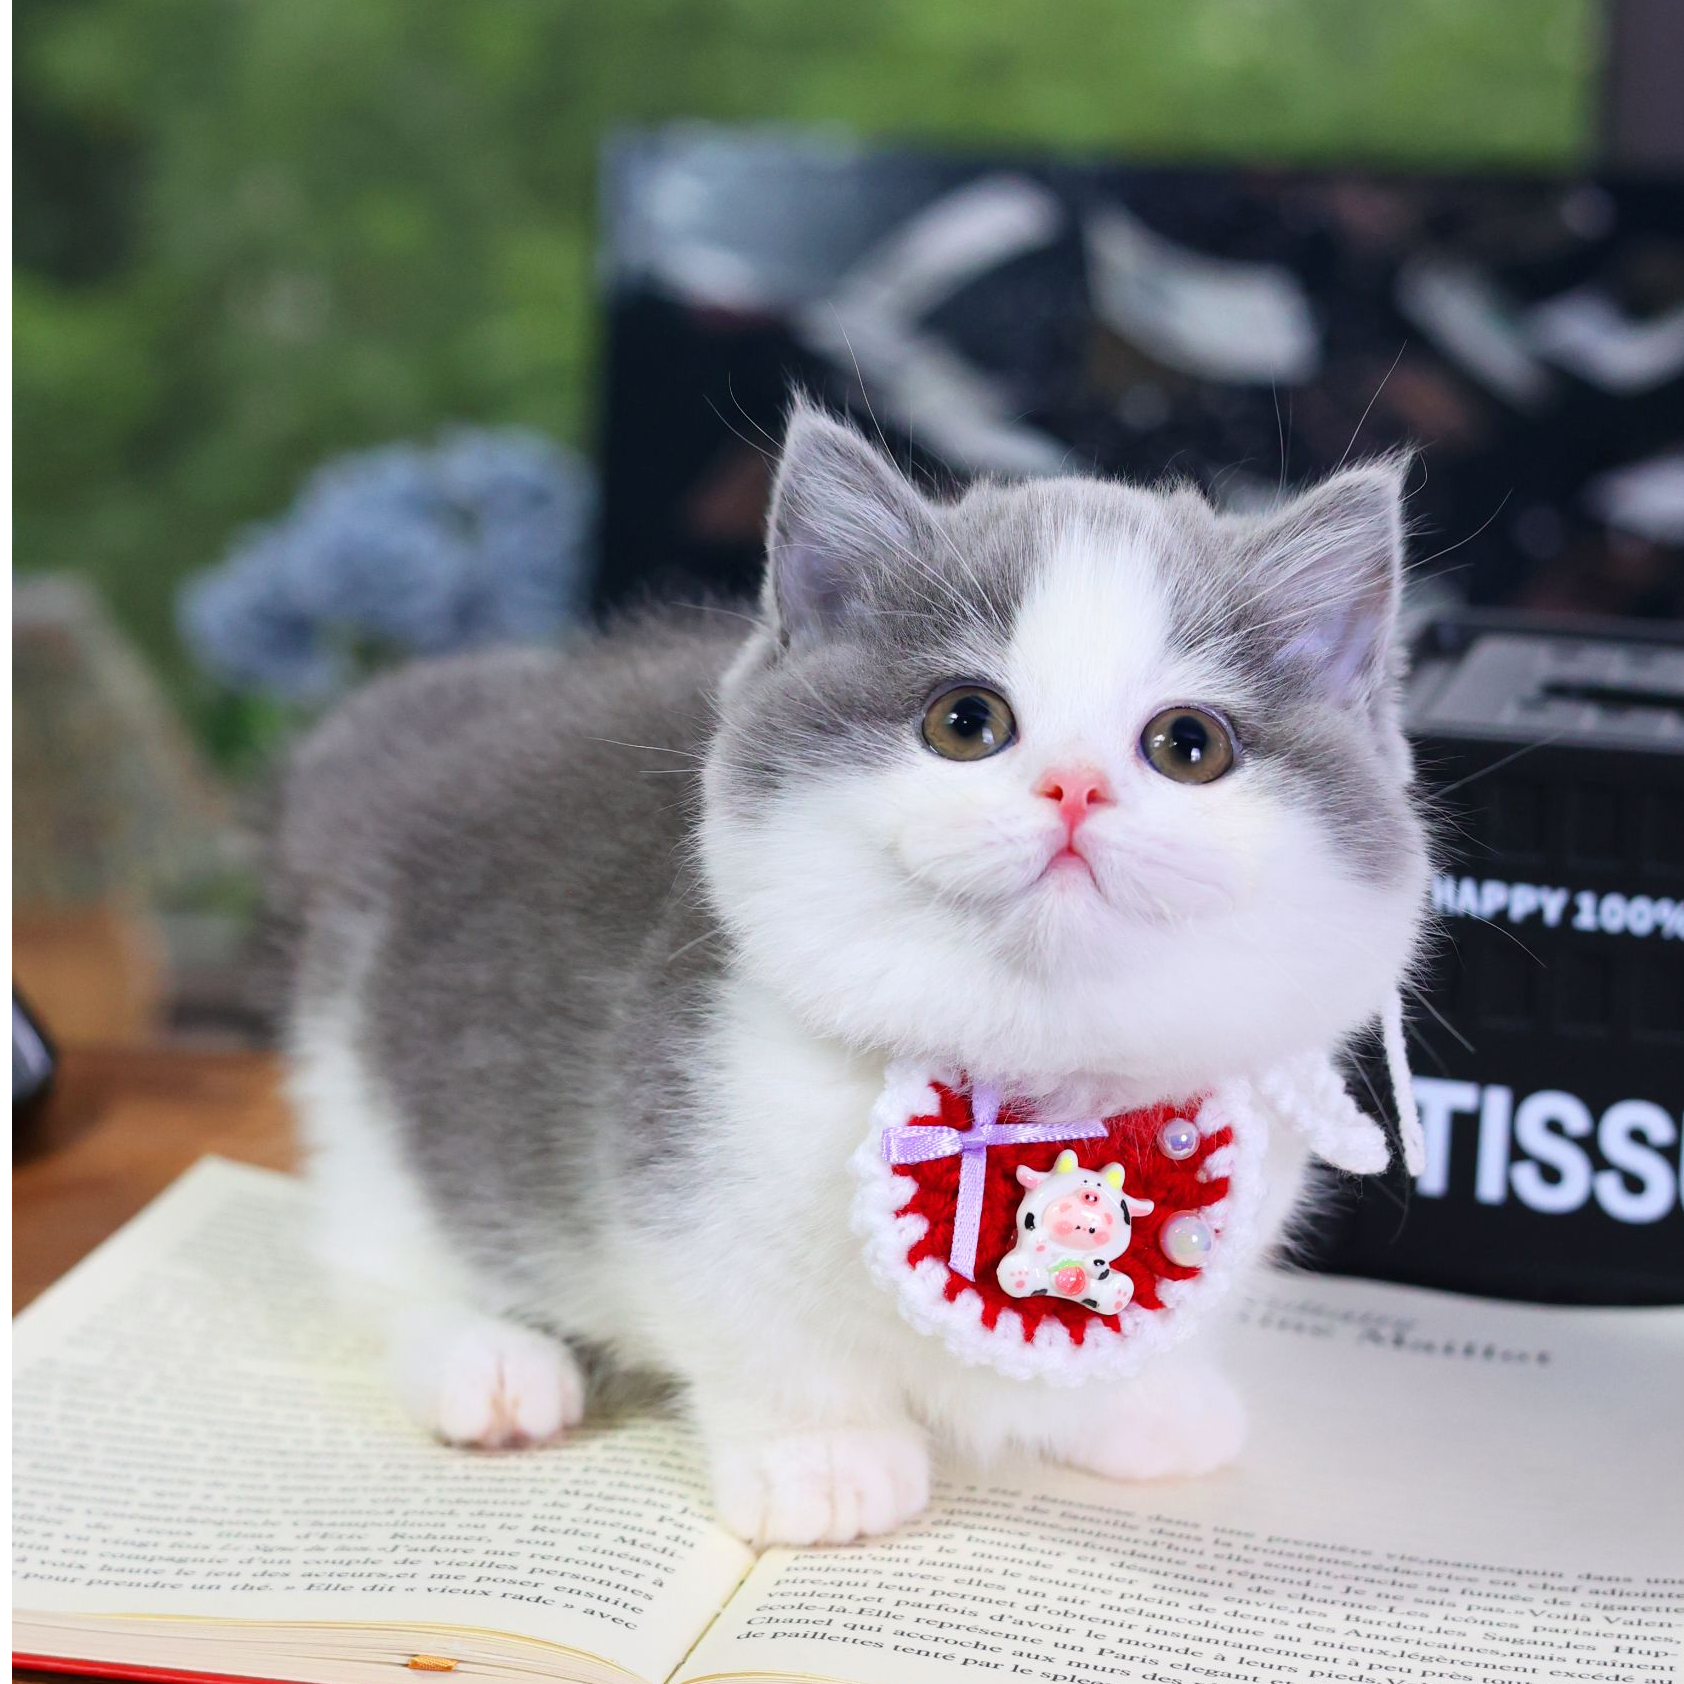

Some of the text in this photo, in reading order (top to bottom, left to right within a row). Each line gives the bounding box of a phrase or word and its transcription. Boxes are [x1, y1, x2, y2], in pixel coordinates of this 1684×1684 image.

[1430, 873, 1569, 928] HAPPY
[1410, 1073, 1684, 1225] TISS
[484, 1549, 520, 1557] me
[529, 1552, 644, 1580] retrouver
[515, 1537, 555, 1547] son
[22, 1571, 76, 1583] pour
[86, 1578, 182, 1590] prendre
[306, 1581, 354, 1592] Elle
[362, 1582, 395, 1592] dit
[427, 1584, 490, 1596] vieux
[583, 1606, 636, 1629] avec
[252, 1568, 289, 1578] des
[430, 1572, 466, 1581] me
[474, 1575, 543, 1588] poser
[554, 1584, 643, 1613] ensuite
[303, 1556, 382, 1567] couple
[393, 1556, 421, 1565] de
[434, 1557, 518, 1570] vieilles
[529, 1566, 653, 1599] personnes
[937, 1543, 956, 1554] le
[972, 1550, 1053, 1570] monde
[1068, 1566, 1137, 1586] entier
[1152, 1582, 1209, 1599] nous
[1614, 1643, 1679, 1659] Hup-
[1427, 1585, 1449, 1594] sa
[1543, 1595, 1571, 1607] de
[1580, 1599, 1684, 1614] cigarette
[1489, 1578, 1516, 1587] en
[1528, 1581, 1578, 1593] chef
[1578, 1570, 1632, 1584] dans
[786, 1563, 882, 1576] toujours
[892, 1570, 944, 1582] avec
[954, 1576, 1005, 1591] elles
[1017, 1587, 1046, 1598] un
[1057, 1594, 1089, 1606] air
[1100, 1602, 1263, 1637] mélancolique
[1274, 1632, 1300, 1643] au
[1549, 1669, 1634, 1683] excédé
[876, 1579, 924, 1594] leur
[930, 1588, 1014, 1608] permet
[1025, 1601, 1137, 1630] d'obtenir
[1368, 1662, 1411, 1674] peu
[1421, 1669, 1472, 1682] près
[894, 1598, 977, 1618] parfois
[989, 1611, 1075, 1635] d'avoir
[1086, 1628, 1106, 1640] le
[1118, 1636, 1203, 1658] monde
[1238, 1655, 1297, 1673] leurs
[918, 1555, 993, 1574] jamais
[1002, 1566, 1021, 1578] le
[1029, 1574, 1111, 1596] sourire
[1119, 1591, 1179, 1608] plein
[1189, 1601, 1216, 1614] de
[1224, 1607, 1288, 1626] dents
[1297, 1619, 1335, 1634] des
[1576, 1656, 1675, 1672] traînent
[1247, 1582, 1275, 1596] de
[1443, 1611, 1519, 1629] icônes
[1532, 1625, 1681, 1647] parisiennes,
[1376, 1591, 1404, 1601] ne
[1414, 1596, 1456, 1608] sais
[1604, 1614, 1683, 1628] Valen-
[737, 1629, 1033, 1675] de paillettes tenté par le
[747, 1614, 832, 1626] Chanel
[843, 1621, 881, 1633] qui
[893, 1628, 1002, 1653] accroche
[1012, 1649, 1055, 1663] aux
[1068, 1659, 1130, 1676] murs
[914, 1616, 1042, 1645] représente
[1054, 1641, 1084, 1653] un
[1097, 1645, 1158, 1666] Paris
